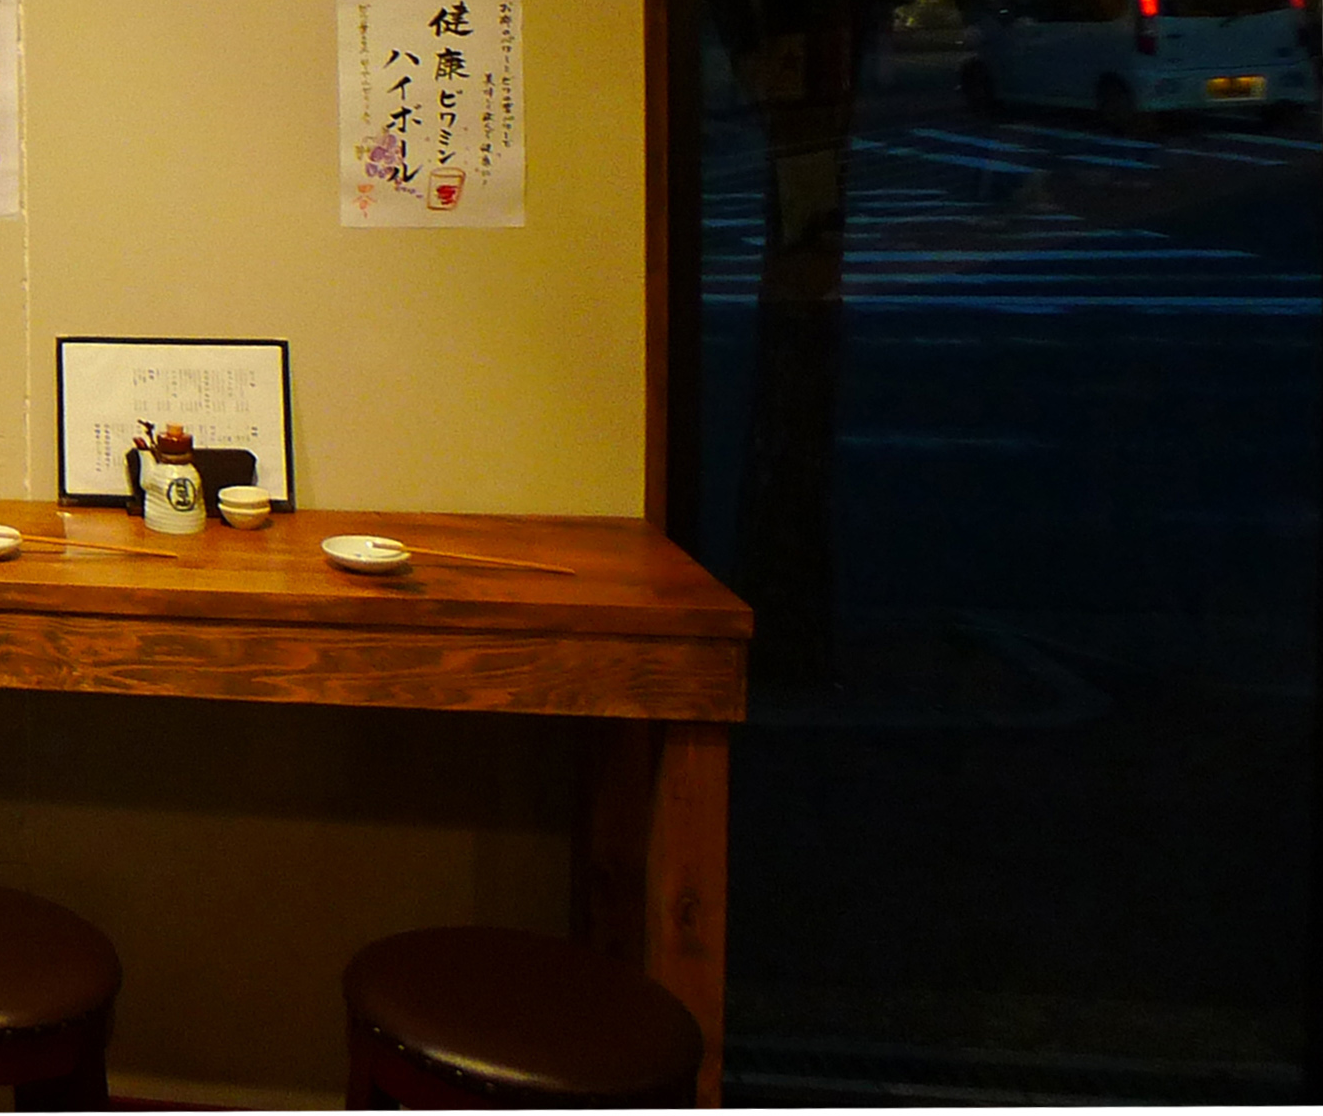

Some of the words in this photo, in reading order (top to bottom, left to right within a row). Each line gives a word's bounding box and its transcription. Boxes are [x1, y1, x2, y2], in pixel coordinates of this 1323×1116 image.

[383, 48, 424, 184] ハイボール
